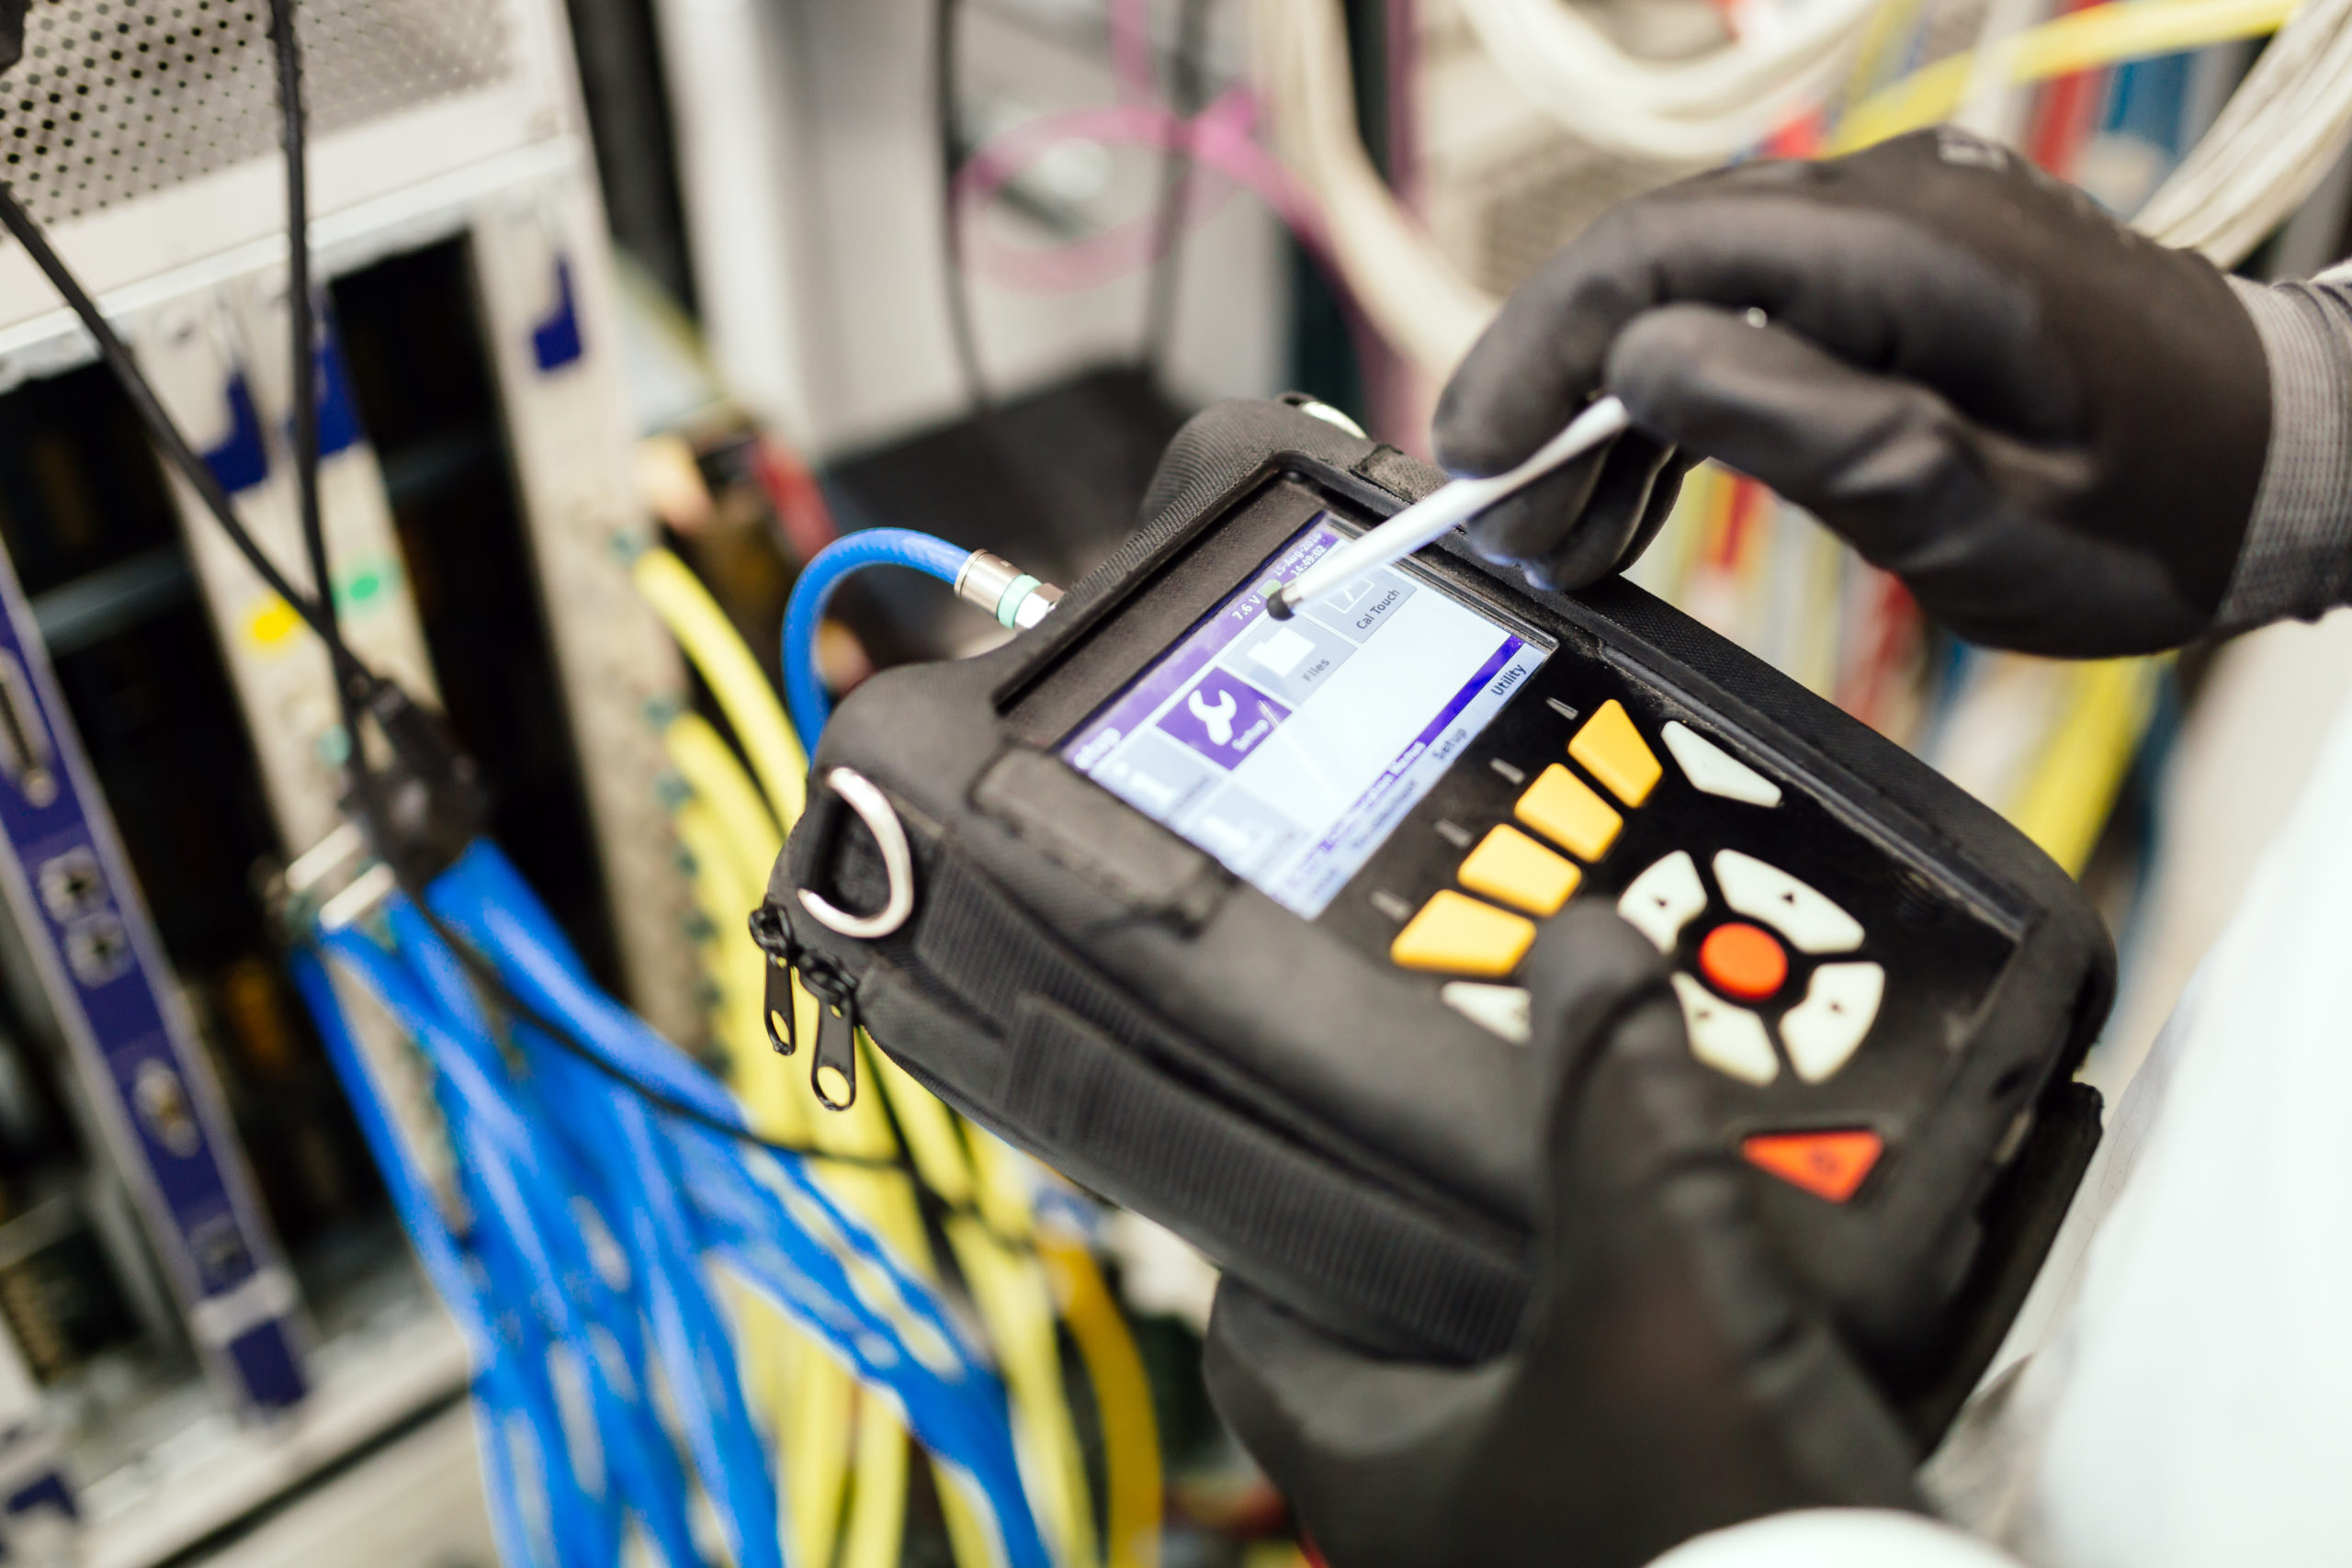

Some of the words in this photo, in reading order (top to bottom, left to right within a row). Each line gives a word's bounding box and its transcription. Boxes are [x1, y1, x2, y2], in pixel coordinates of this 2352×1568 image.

[1290, 545, 1327, 576] 14:49:02
[1232, 603, 1253, 620] 7.6
[1248, 594, 1261, 604] V
[1356, 613, 1375, 629] Cal
[1369, 589, 1401, 615] Touch
[1302, 659, 1330, 682] Files
[1490, 664, 1527, 695] Utility
[1431, 728, 1467, 760] Setup
